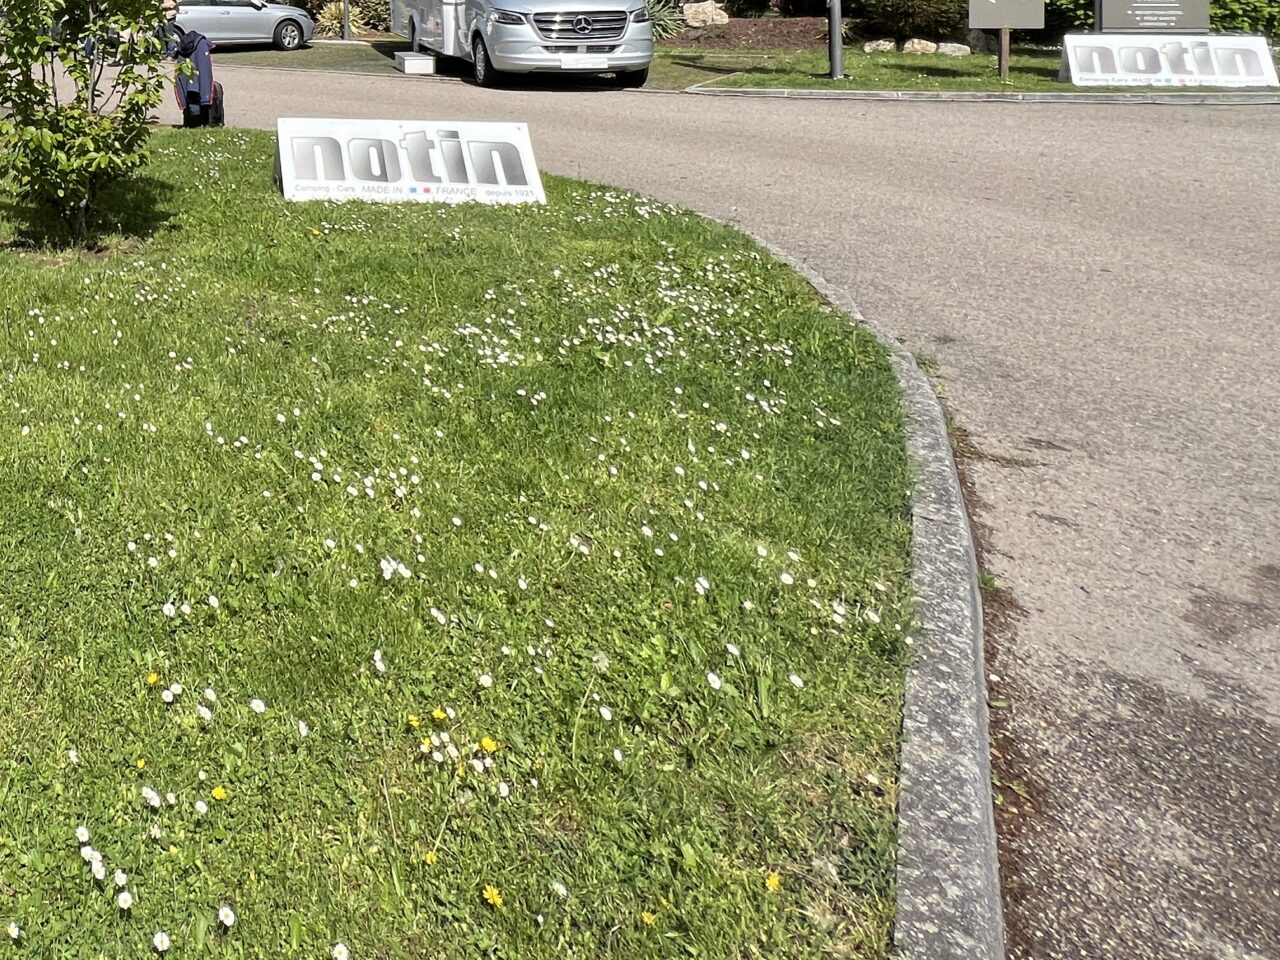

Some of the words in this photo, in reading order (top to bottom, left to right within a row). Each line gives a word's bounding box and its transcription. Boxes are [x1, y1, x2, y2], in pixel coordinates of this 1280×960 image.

[1074, 41, 1265, 76] notin
[291, 130, 528, 185] notin
[361, 185, 390, 194] MADE
[393, 186, 403, 194] IN
[436, 187, 477, 195] FRANCE
